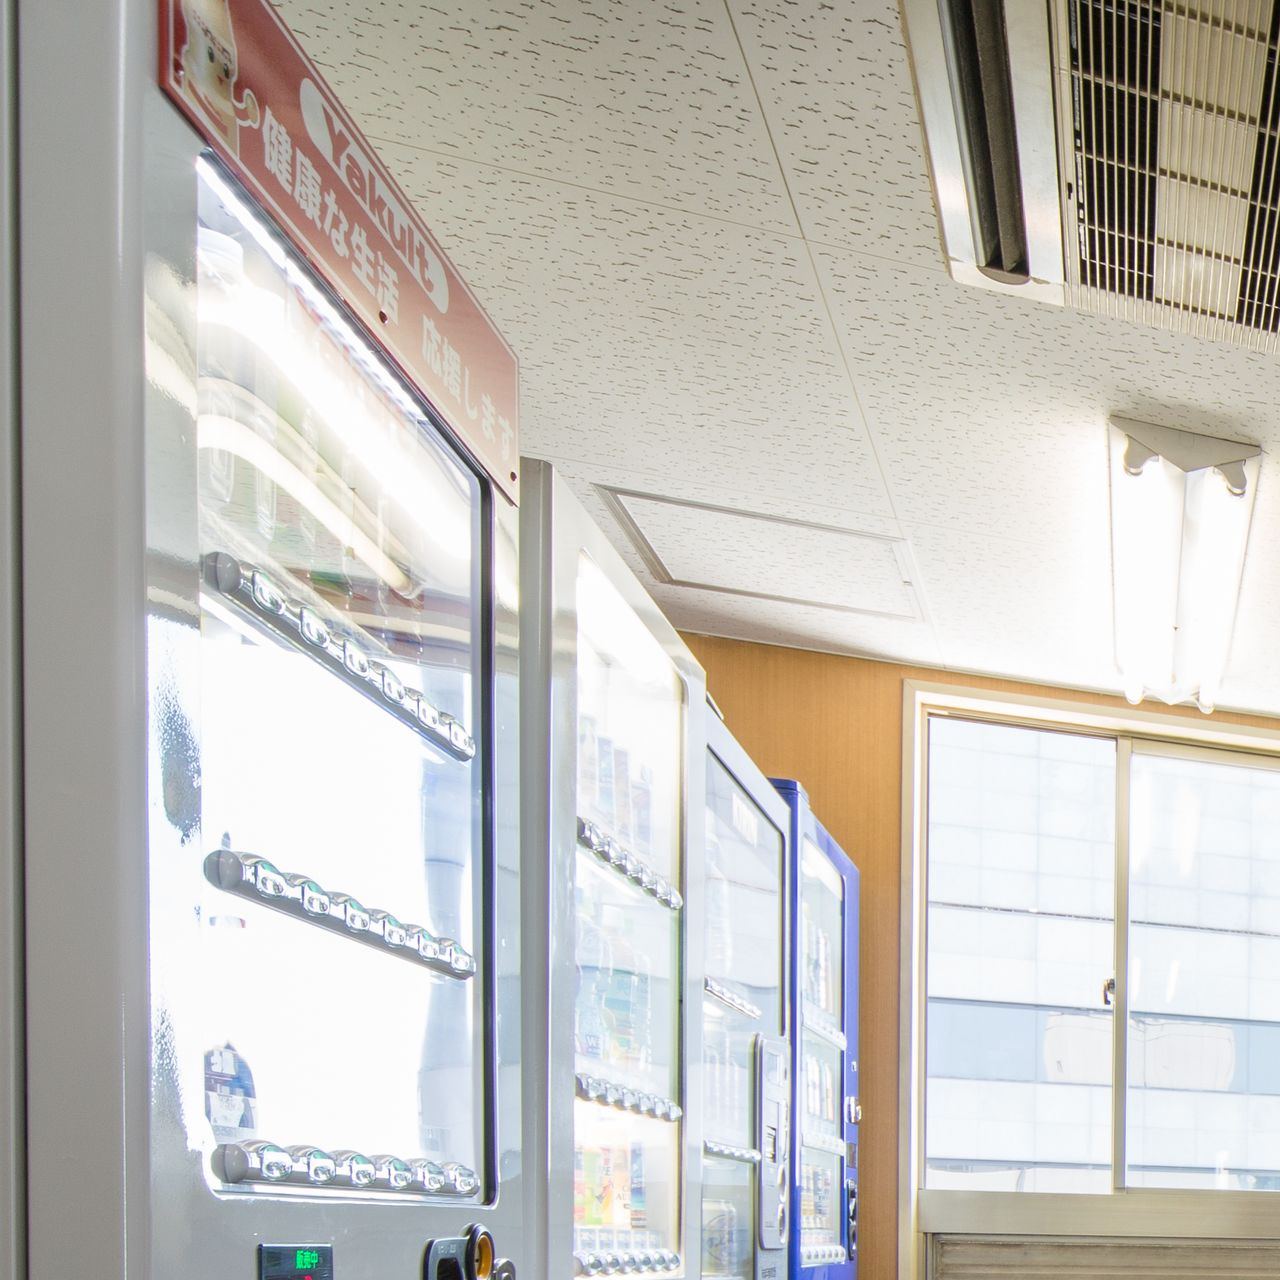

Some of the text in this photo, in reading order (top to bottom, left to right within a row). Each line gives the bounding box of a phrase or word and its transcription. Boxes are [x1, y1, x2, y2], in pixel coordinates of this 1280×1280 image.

[262, 105, 400, 314] 健康な生活
[320, 102, 442, 297] Yakult
[421, 314, 515, 462] 応援します
[295, 1250, 319, 1270] 販売中
